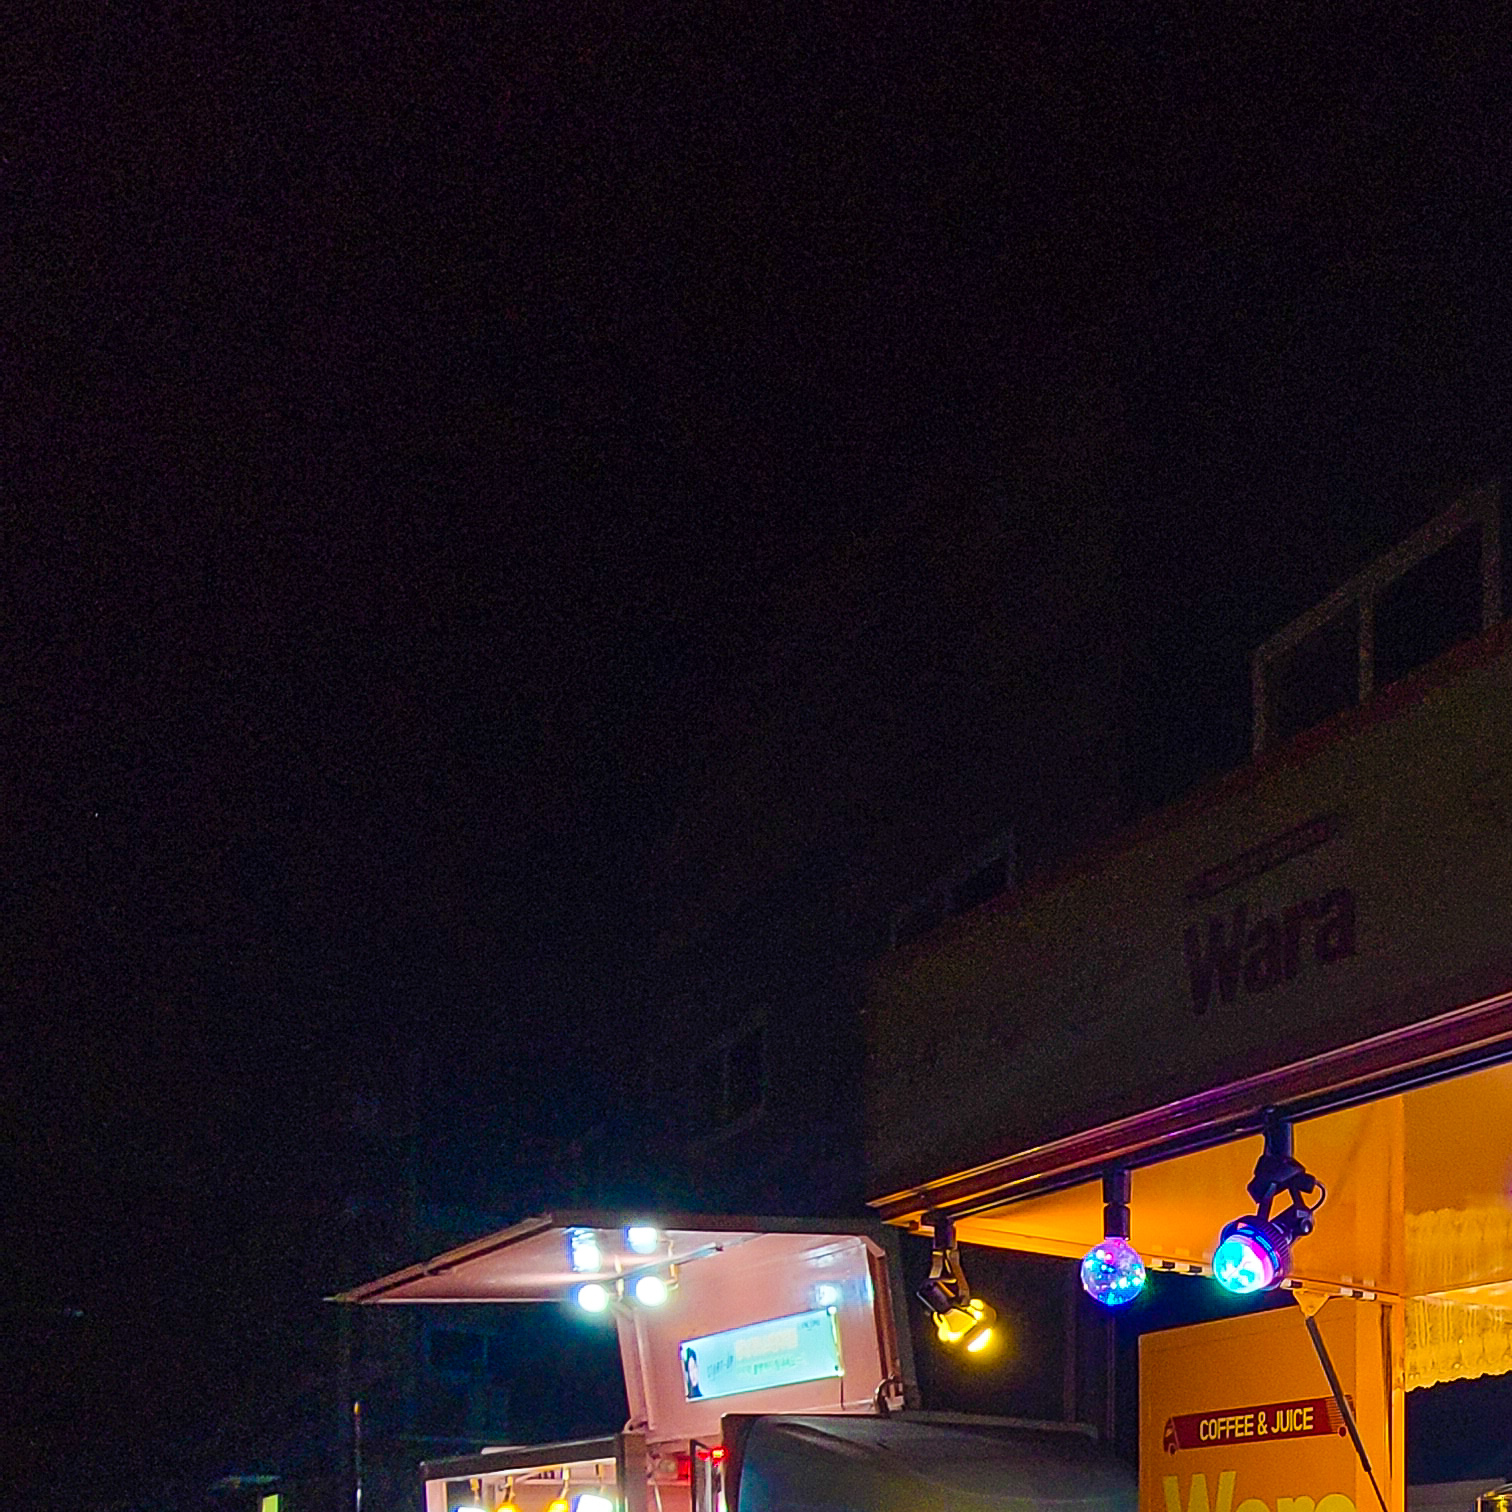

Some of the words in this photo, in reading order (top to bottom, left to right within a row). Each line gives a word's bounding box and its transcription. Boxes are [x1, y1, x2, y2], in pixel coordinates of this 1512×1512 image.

[1183, 886, 1355, 1016] Wara
[1200, 1415, 1254, 1441] COFFEE
[1257, 1412, 1268, 1436] &
[1271, 1407, 1314, 1433] JUICE
